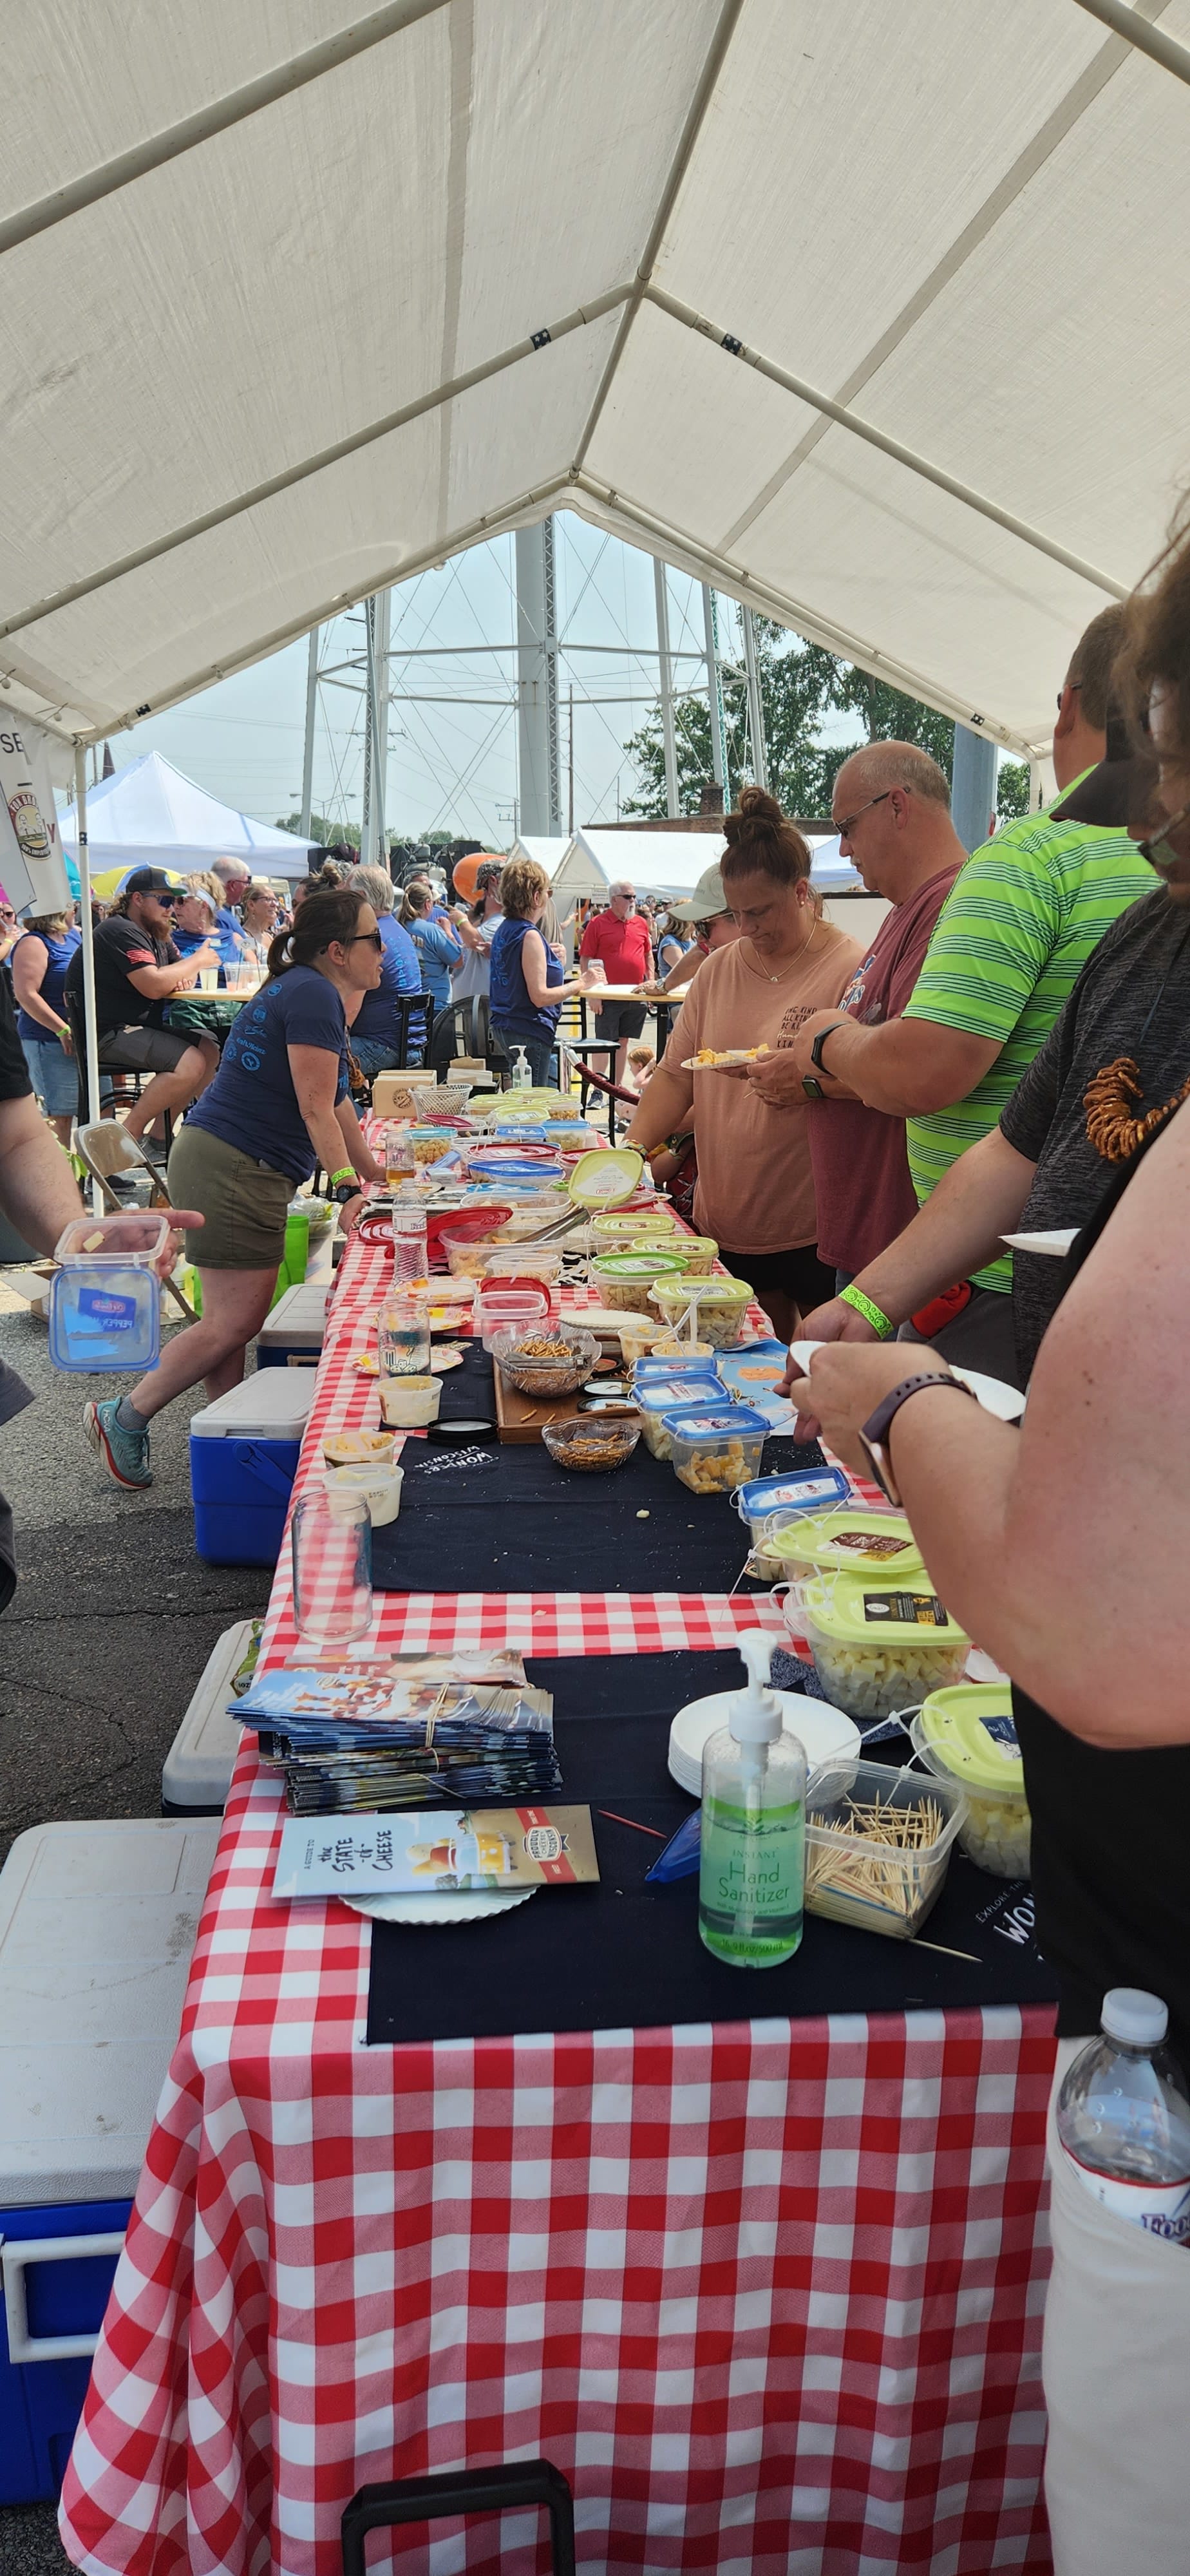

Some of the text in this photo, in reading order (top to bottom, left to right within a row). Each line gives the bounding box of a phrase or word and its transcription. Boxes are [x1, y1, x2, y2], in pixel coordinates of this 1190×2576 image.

[10, 798, 23, 813] FOX
[795, 1014, 811, 1023] KIN
[102, 1408, 111, 1433] HOKA
[414, 1444, 481, 1468] WISCONSIN
[317, 1846, 334, 1863] the
[331, 1836, 356, 1873] STATE
[371, 1829, 394, 1871] CHEESE
[530, 1830, 542, 1859] PROUDLY
[545, 1828, 558, 1858] WISCONSIN
[732, 1849, 776, 1859] INSTANT
[729, 1860, 780, 1884] Hand
[718, 1876, 790, 1904] Sanitizer
[975, 1890, 1011, 1924] EXPLORE
[1141, 2213, 1190, 2239] Foo
